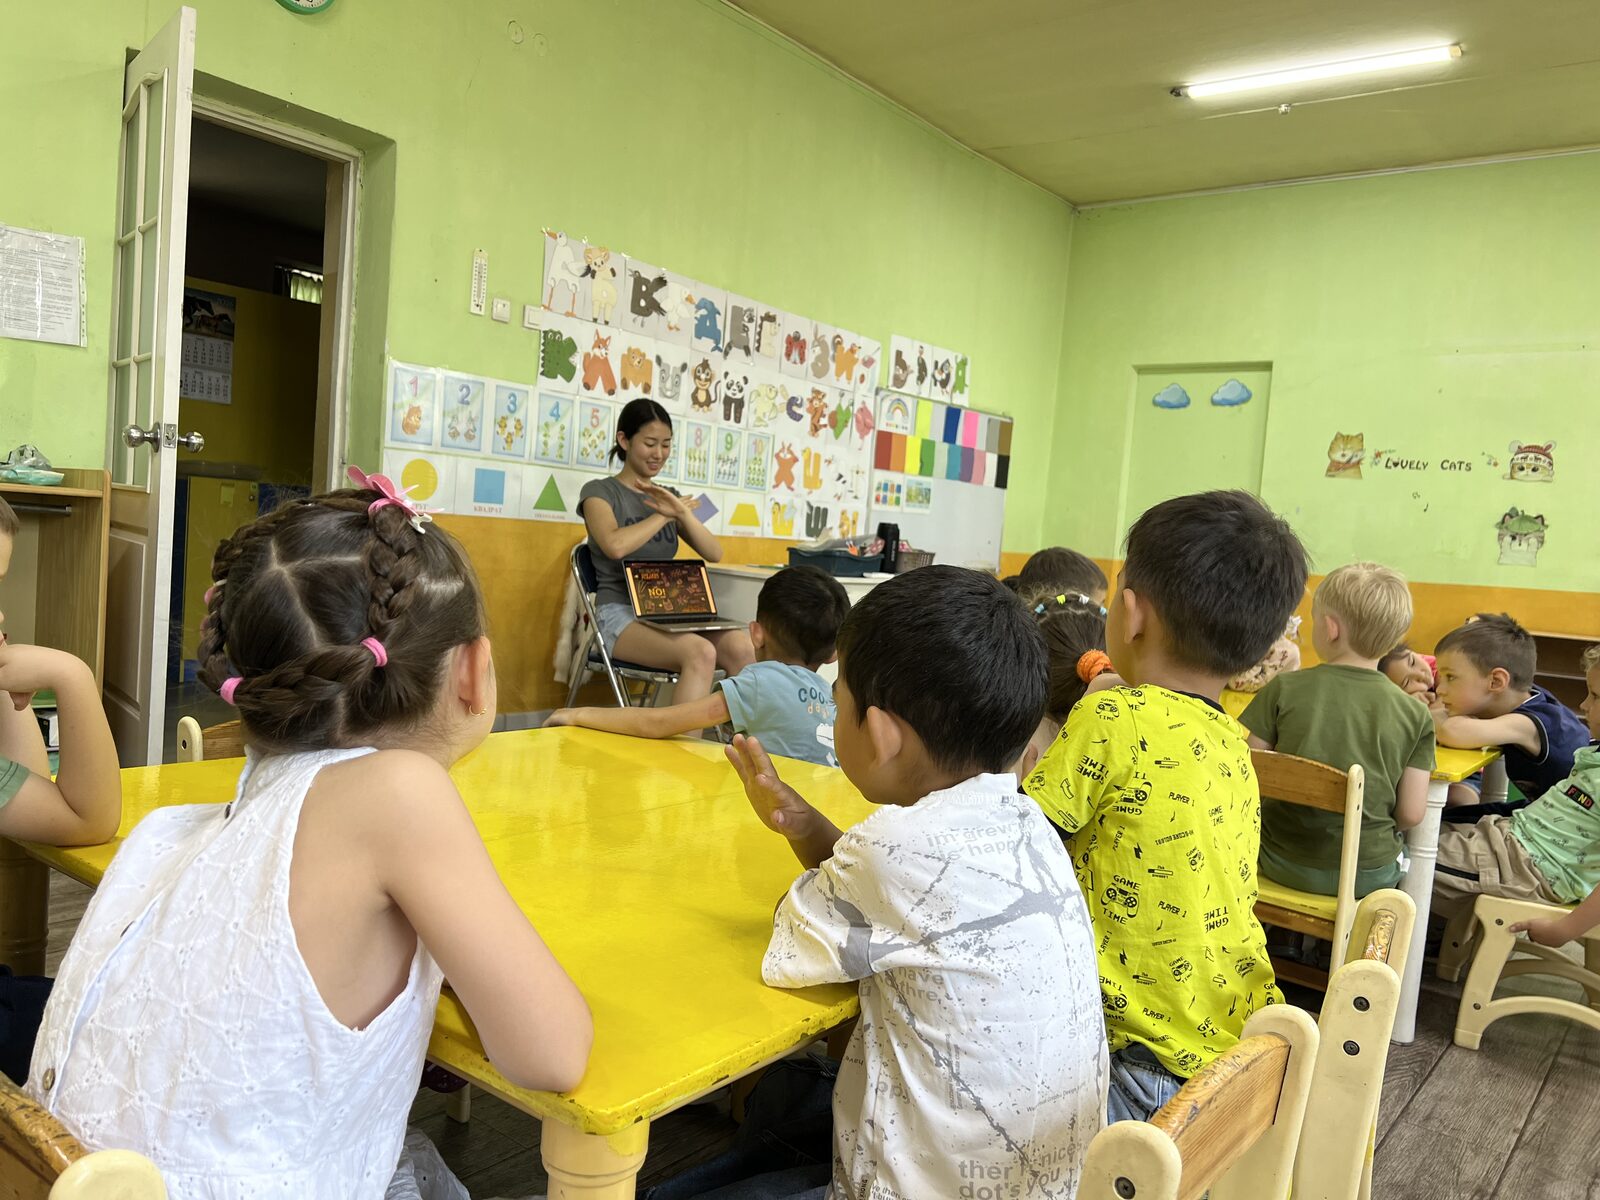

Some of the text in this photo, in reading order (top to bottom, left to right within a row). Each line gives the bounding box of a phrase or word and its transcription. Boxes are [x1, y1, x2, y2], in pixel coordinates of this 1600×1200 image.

[408, 376, 420, 398] 1
[458, 384, 472, 406] 2
[507, 392, 518, 414] 3
[549, 401, 561, 422] 4
[590, 408, 600, 428] 5
[724, 431, 734, 451] 9
[648, 587, 666, 597] NO!
[1168, 791, 1190, 804] PLAYER
[1112, 805, 1143, 815] GAME
[1113, 875, 1141, 891] GAME
[1158, 900, 1180, 915] PLAYER
[1204, 906, 1229, 922] TIME
[1103, 908, 1128, 925] TIME
[1206, 917, 1229, 933] GAME
[1098, 935, 1110, 956] PLAYER
[1143, 1008, 1165, 1020] PLAYER
[1026, 1167, 1061, 1196] you
